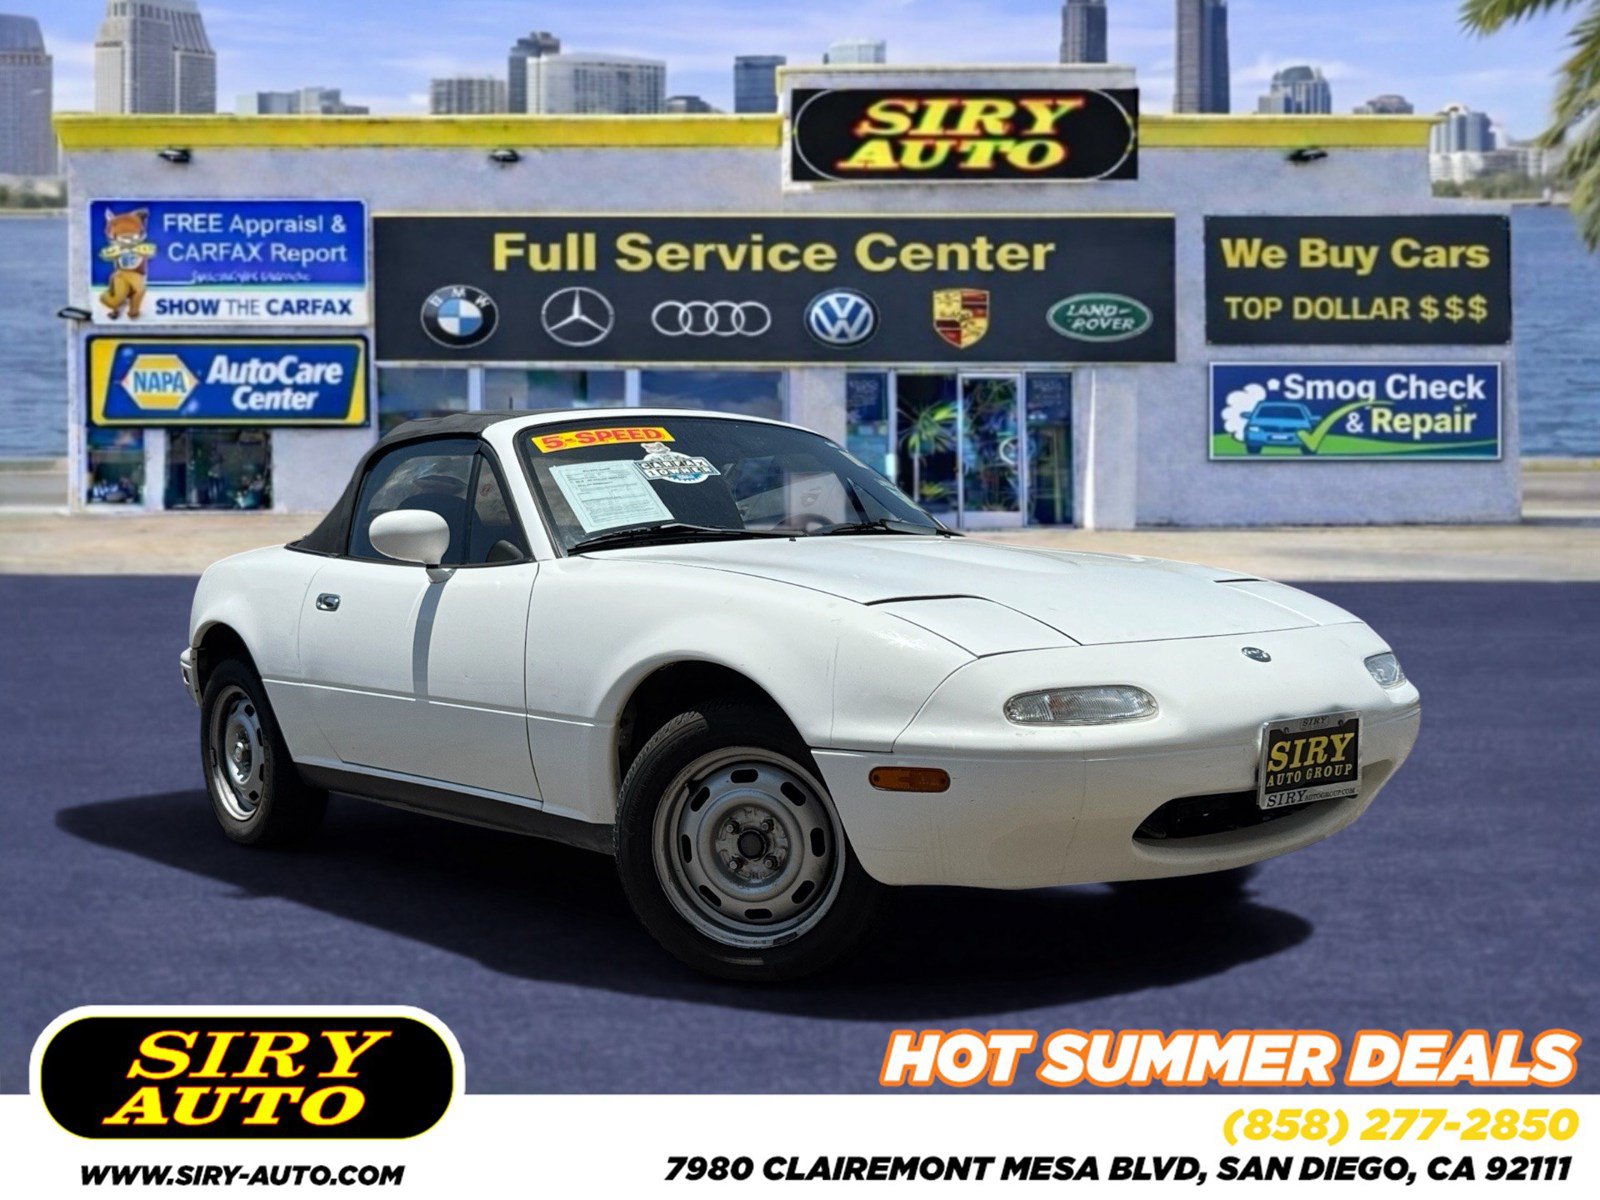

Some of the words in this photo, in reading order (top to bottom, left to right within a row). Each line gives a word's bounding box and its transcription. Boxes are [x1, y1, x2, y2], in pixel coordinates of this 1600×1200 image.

[855, 98, 1085, 137] SIRY
[836, 139, 1068, 170] AUTO
[162, 213, 223, 232] FREE
[331, 215, 346, 232] &
[168, 242, 263, 262] CARFAX
[271, 244, 348, 266] Report
[493, 232, 597, 271] Full
[615, 232, 837, 272] Service
[855, 232, 1056, 272] Center
[1220, 238, 1288, 268] We
[1299, 238, 1379, 276] Buy
[1391, 237, 1490, 268] Cars
[155, 298, 220, 315] SHOW
[226, 299, 260, 315] THE
[266, 298, 353, 315] CARFAX
[1223, 297, 1283, 320] TOP
[1292, 297, 1411, 320] DOLLAR
[1071, 317, 1135, 331] ROVER
[205, 355, 344, 385] AutoCare
[133, 371, 187, 394] NAPA
[1385, 373, 1486, 399] Check
[231, 387, 319, 411] Center
[1346, 411, 1365, 433] &
[1371, 404, 1478, 440] Repair
[541, 427, 662, 450] 5-SPEED
[1302, 716, 1328, 727] SIRY
[1267, 732, 1355, 772] SIRY
[1266, 770, 1302, 787] AUTO
[1305, 763, 1353, 781] GROUP
